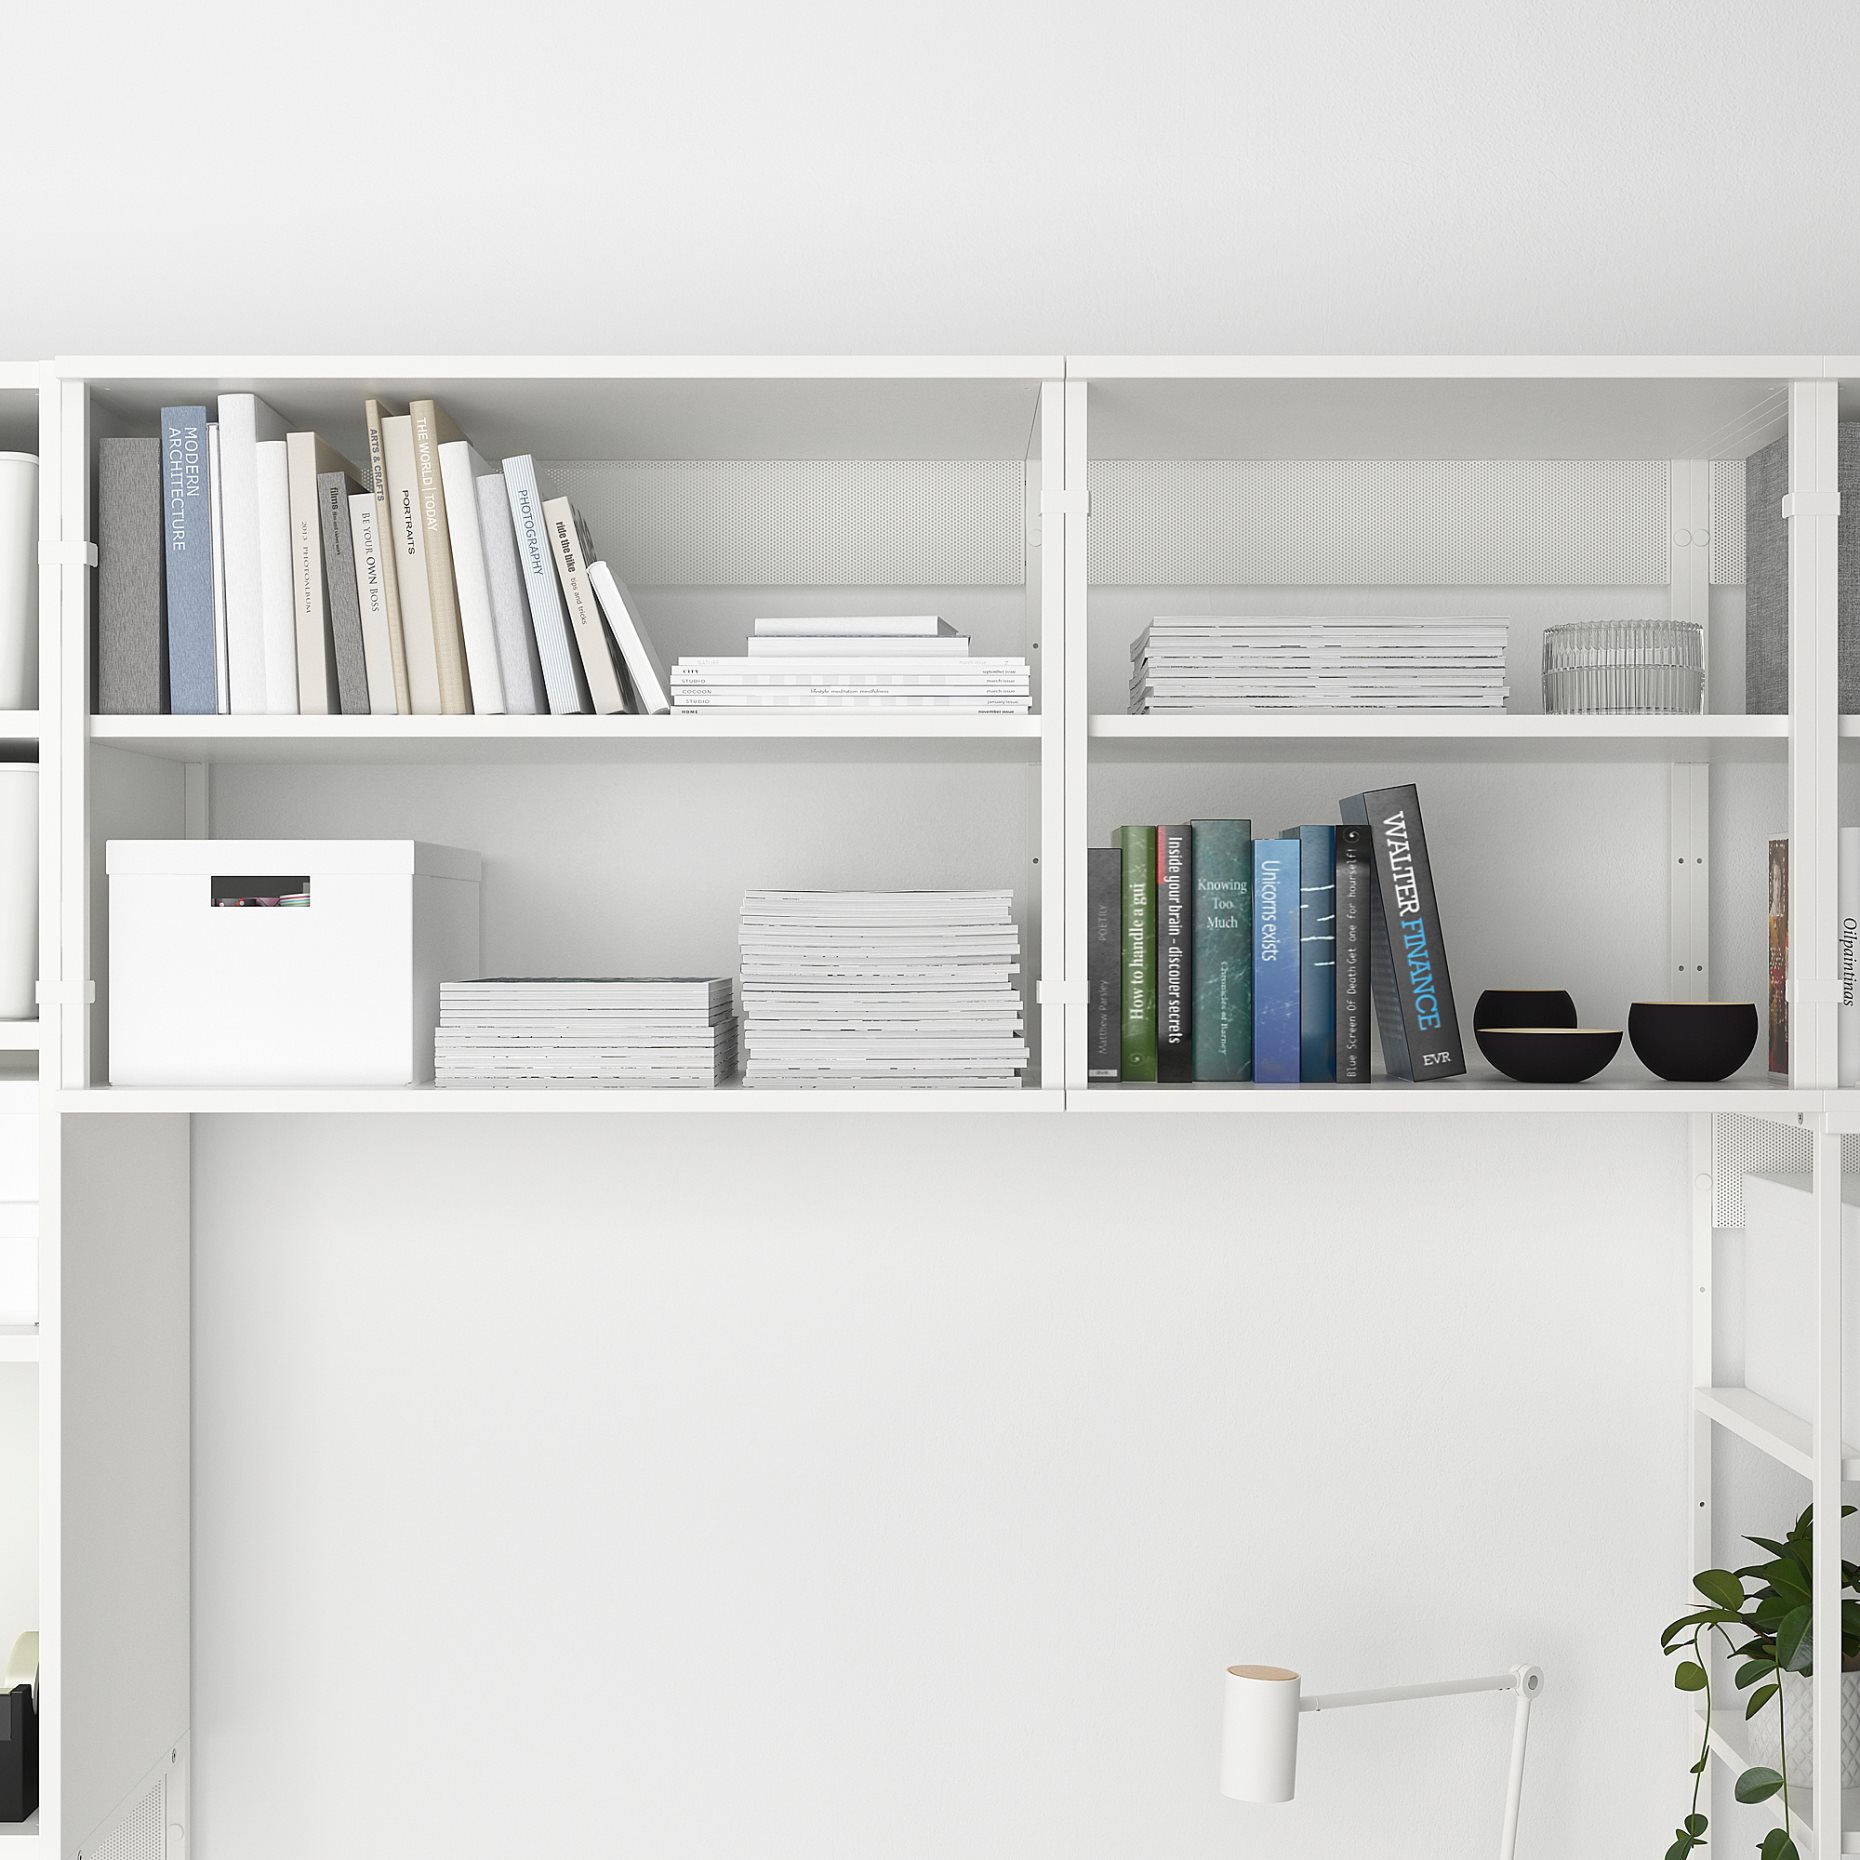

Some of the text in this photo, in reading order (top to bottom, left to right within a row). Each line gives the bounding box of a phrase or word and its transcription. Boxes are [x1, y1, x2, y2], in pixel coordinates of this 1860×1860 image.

[369, 428, 380, 454] ARTS
[416, 416, 428, 441] THE
[184, 427, 200, 497] MODERN
[418, 441, 432, 487] WORLD
[169, 427, 186, 551] ARCHITECTURE
[330, 487, 339, 510] films
[374, 465, 385, 502] CRAFTS
[401, 489, 416, 555] PORTRAITS
[424, 492, 438, 532] TODAY
[518, 488, 544, 576] PHOTOGRAPHY
[555, 521, 577, 573] ride the bike
[303, 546, 312, 614] PHOTOALBUM
[361, 511, 380, 613] BE YOUR OWN BOSS
[570, 577, 588, 625] tips and tricks
[1168, 836, 1183, 873] Inside
[1163, 874, 1182, 903] your
[1197, 877, 1248, 893] Knowing
[1212, 896, 1235, 910] Too
[1098, 904, 1108, 942] POETRY
[1168, 904, 1183, 936] brain
[1206, 915, 1239, 929] Much
[1261, 859, 1281, 962] Unicorns exists
[1346, 903, 1357, 920] for
[1383, 810, 1442, 1033] WALTER FINANCE
[1128, 883, 1147, 1021] How to handle a gui
[1348, 925, 1357, 942] one
[1168, 945, 1183, 998] discover
[1346, 947, 1357, 965] Get
[1346, 966, 1357, 995] Death
[1168, 999, 1183, 1044] secrets
[1346, 999, 1357, 1011] Of
[1097, 1013, 1108, 1056] Matthew
[1346, 1016, 1357, 1050] Screen
[1346, 1054, 1357, 1078] Blue
[1422, 1051, 1452, 1066] EVR
